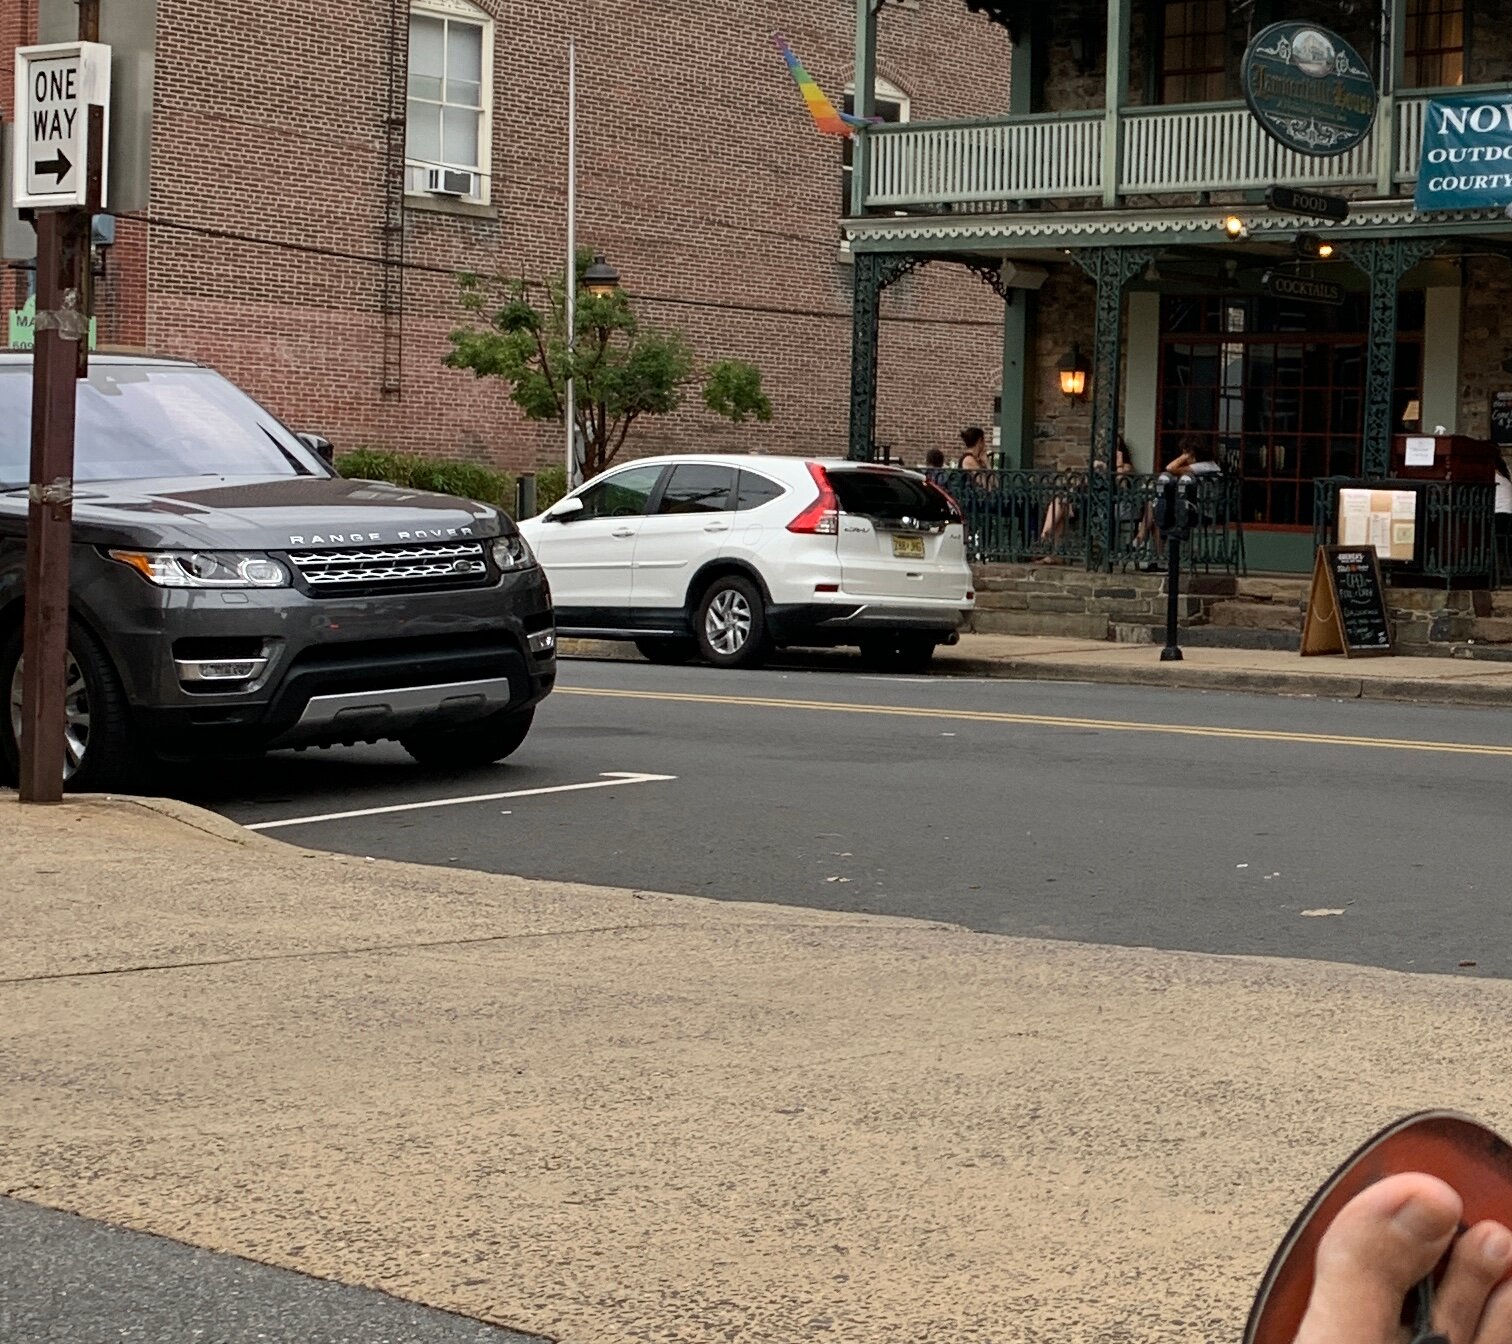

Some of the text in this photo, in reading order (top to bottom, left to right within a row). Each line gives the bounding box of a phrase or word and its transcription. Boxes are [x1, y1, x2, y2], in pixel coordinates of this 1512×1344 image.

[35, 68, 77, 102] ONE
[34, 107, 78, 141] WAY
[1292, 195, 1328, 212] FOOD
[1275, 278, 1338, 299] COCKTAILS
[289, 527, 474, 545] RANGE ROVER
